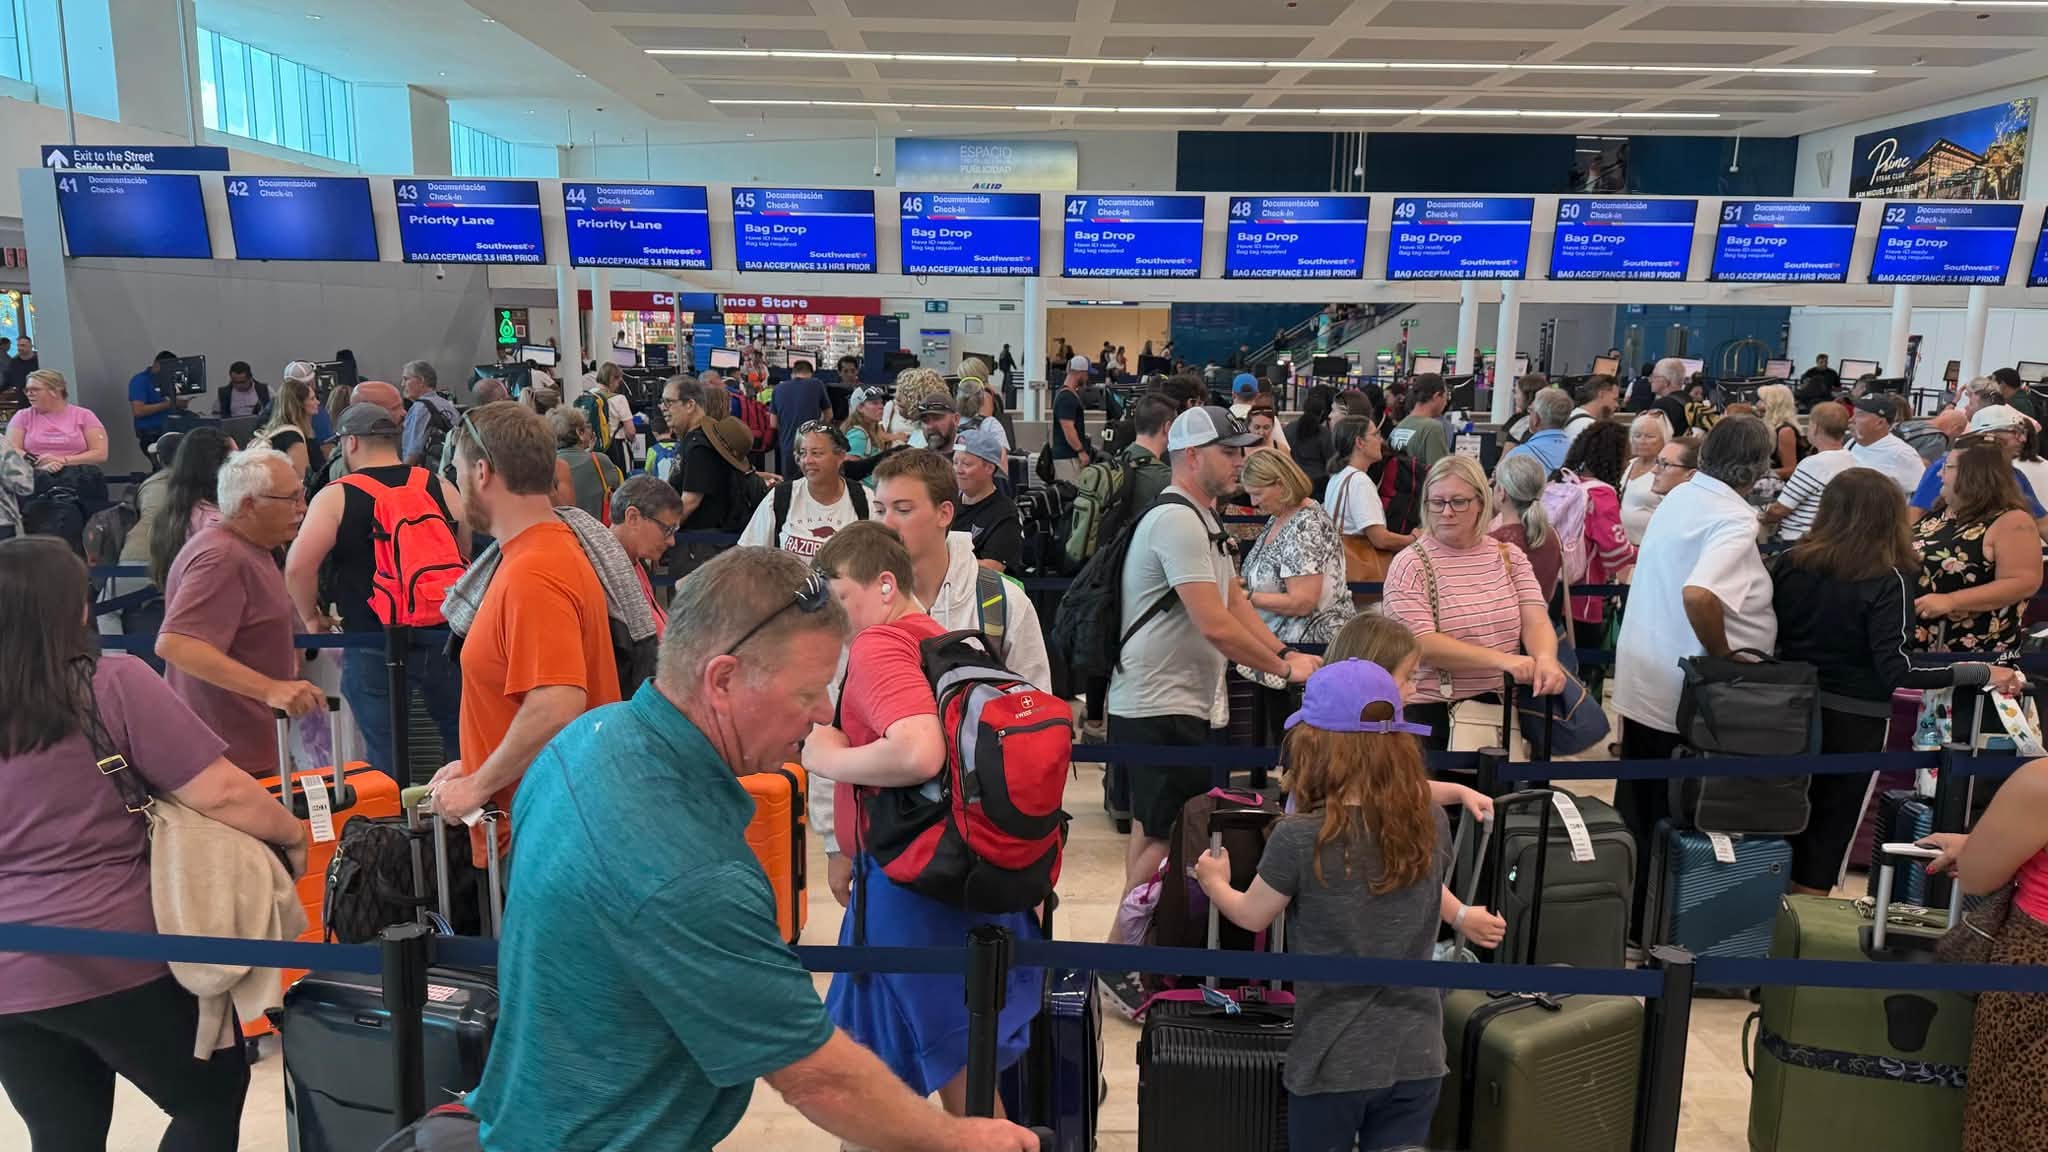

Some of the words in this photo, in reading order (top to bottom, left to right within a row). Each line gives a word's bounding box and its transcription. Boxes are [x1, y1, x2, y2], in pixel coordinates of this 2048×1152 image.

[73, 150, 92, 161] Exit
[94, 151, 105, 161] to
[106, 150, 123, 161] the
[124, 150, 155, 162] Street
[960, 145, 1012, 158] ESPACIO
[59, 177, 78, 193] 41
[228, 181, 249, 196] 42
[428, 183, 486, 191] Documentación
[259, 189, 293, 197] Check-in
[397, 184, 418, 200] 43
[566, 188, 586, 204] 44
[596, 187, 655, 196] Documentación
[765, 191, 823, 200] Documentación
[429, 192, 462, 201] Check-in
[598, 197, 631, 205] Check-in
[735, 193, 755, 208] 45
[933, 195, 990, 204] Documentación
[766, 201, 799, 209] Check-in
[903, 197, 922, 212] 46
[1098, 198, 1154, 206] Documentación
[1592, 202, 1647, 210] Documentación
[933, 205, 966, 213] Check-in
[1067, 200, 1087, 215] 47
[1098, 208, 1130, 216] Check-in
[1232, 201, 1251, 216] 48
[1395, 203, 1415, 218] 49
[1561, 203, 1579, 218] 50
[1754, 204, 1811, 212] Documentación
[1917, 206, 1972, 214] Documentación
[1262, 209, 1294, 217] Check-in
[1590, 211, 1622, 219] Check-in
[1723, 205, 1742, 221] 51
[1886, 208, 1906, 223] 52
[409, 215, 459, 227] Priority
[462, 216, 495, 225] Lane
[576, 219, 627, 231] Priority
[630, 220, 662, 230] Lane
[745, 224, 770, 235] Bag
[773, 224, 807, 235] Drop
[911, 228, 936, 238] Bag
[940, 228, 972, 239] Drop
[1074, 231, 1099, 241] Bag
[1103, 231, 1135, 242] Drop
[1238, 232, 1262, 243] Bag
[1265, 233, 1298, 243] Drop
[1400, 233, 1425, 244] Bag
[1429, 233, 1462, 244] Drop
[1564, 234, 1589, 244] Bag
[1592, 234, 1625, 245] Drop
[476, 242, 528, 250] Southwest
[1726, 236, 1751, 246] Bag
[1754, 236, 1787, 247] Drop
[1887, 238, 1912, 248] Bag
[1915, 239, 1948, 248] Drop
[643, 247, 694, 255] Southwest
[431, 253, 482, 261] ACCEPTANCE
[497, 254, 513, 262] HRS
[514, 254, 539, 262] PRIOR
[578, 256, 596, 264] BAG
[597, 257, 649, 265] ACCEPTANCE
[663, 258, 680, 266] HRS
[681, 259, 705, 267] PRIOR
[745, 261, 762, 269] BAG
[764, 261, 815, 270] ACCEPTANCE
[829, 262, 845, 270] HRS
[846, 262, 870, 270] PRIOR
[928, 265, 978, 273] ACCEPTANCE
[1009, 266, 1033, 274] PRIOR
[1089, 268, 1139, 276] ACCEPTANCE
[1233, 269, 1249, 277] BAG
[1251, 269, 1301, 277] ACCEPTANCE
[1315, 269, 1331, 277] HRS
[1333, 269, 1357, 277] PRIOR
[1394, 270, 1411, 278] BAG
[1413, 270, 1464, 278] ACCEPTANCE
[1477, 270, 1493, 278] HRS
[1495, 270, 1520, 278] PRIOR
[1557, 270, 1574, 278] BAG
[1718, 272, 1735, 280] BAG
[1737, 272, 1786, 280] ACCEPTANCE
[1878, 274, 1895, 282] BAG
[1896, 274, 1945, 282] ACCEPTANCE
[1976, 275, 2000, 283] PRIOR
[762, 296, 808, 308] Store
